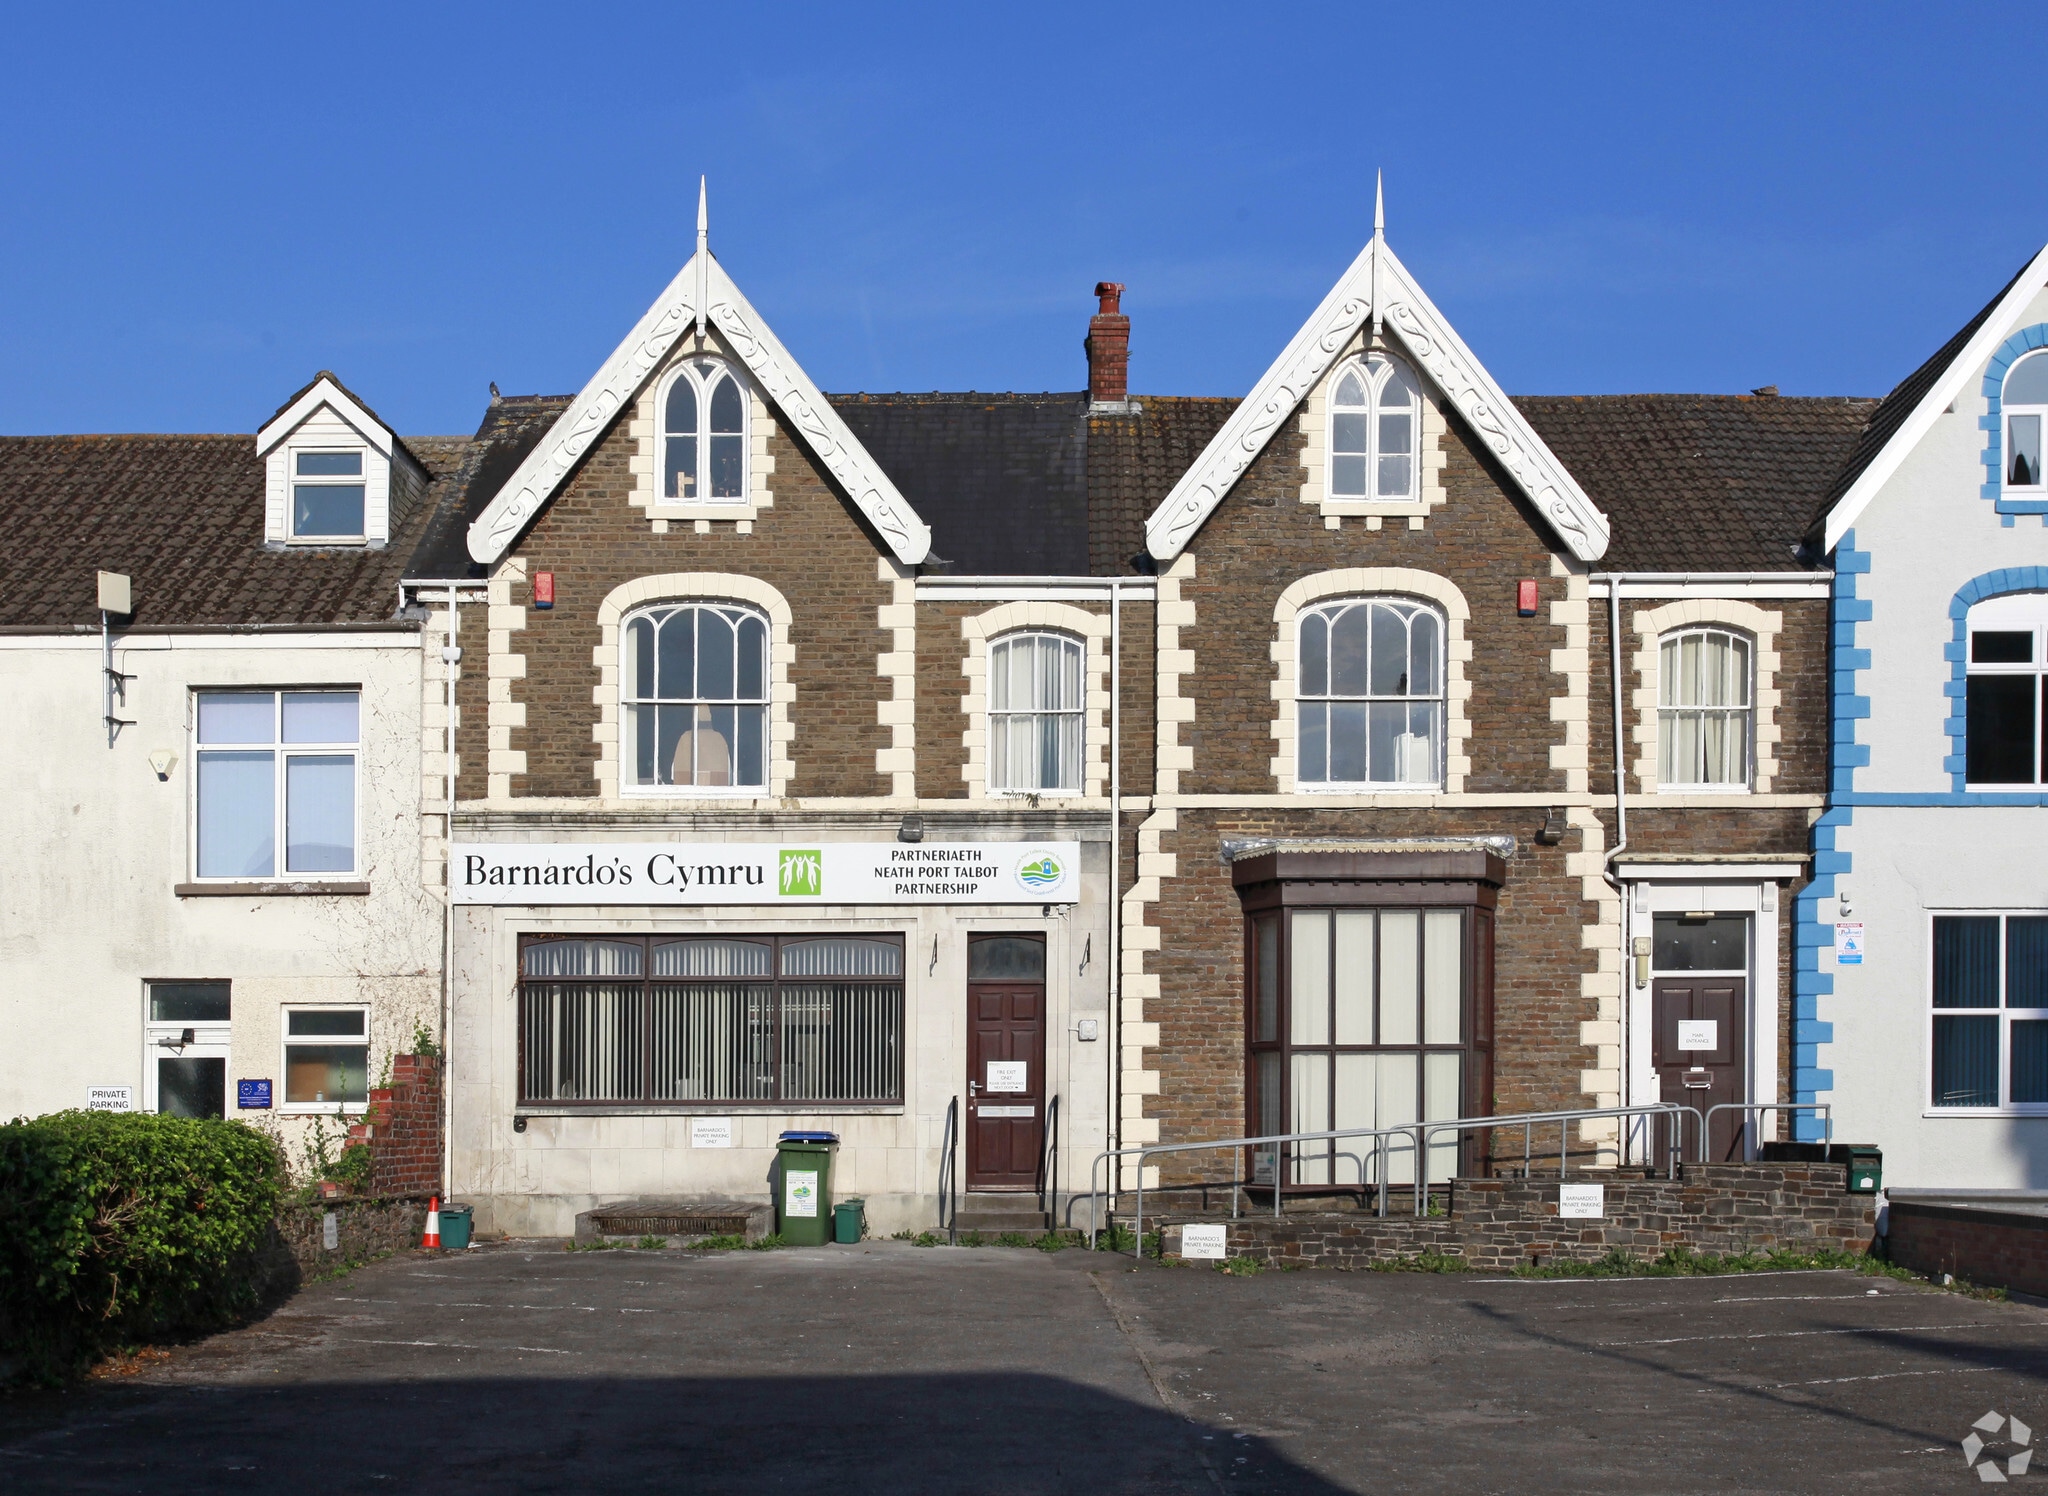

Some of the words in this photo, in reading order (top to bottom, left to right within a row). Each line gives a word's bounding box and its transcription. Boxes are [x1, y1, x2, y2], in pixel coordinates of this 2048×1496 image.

[891, 850, 982, 861] PARTNERIAETH
[464, 854, 633, 886] Barnardo's
[647, 854, 764, 893] Cymru
[874, 866, 914, 878] NEATH
[918, 866, 949, 878] PORT
[954, 866, 999, 878] TALBOT
[895, 883, 978, 894] PARTNERSHIP
[91, 1090, 127, 1098] PRIVATE
[90, 1100, 129, 1109] PARKING
